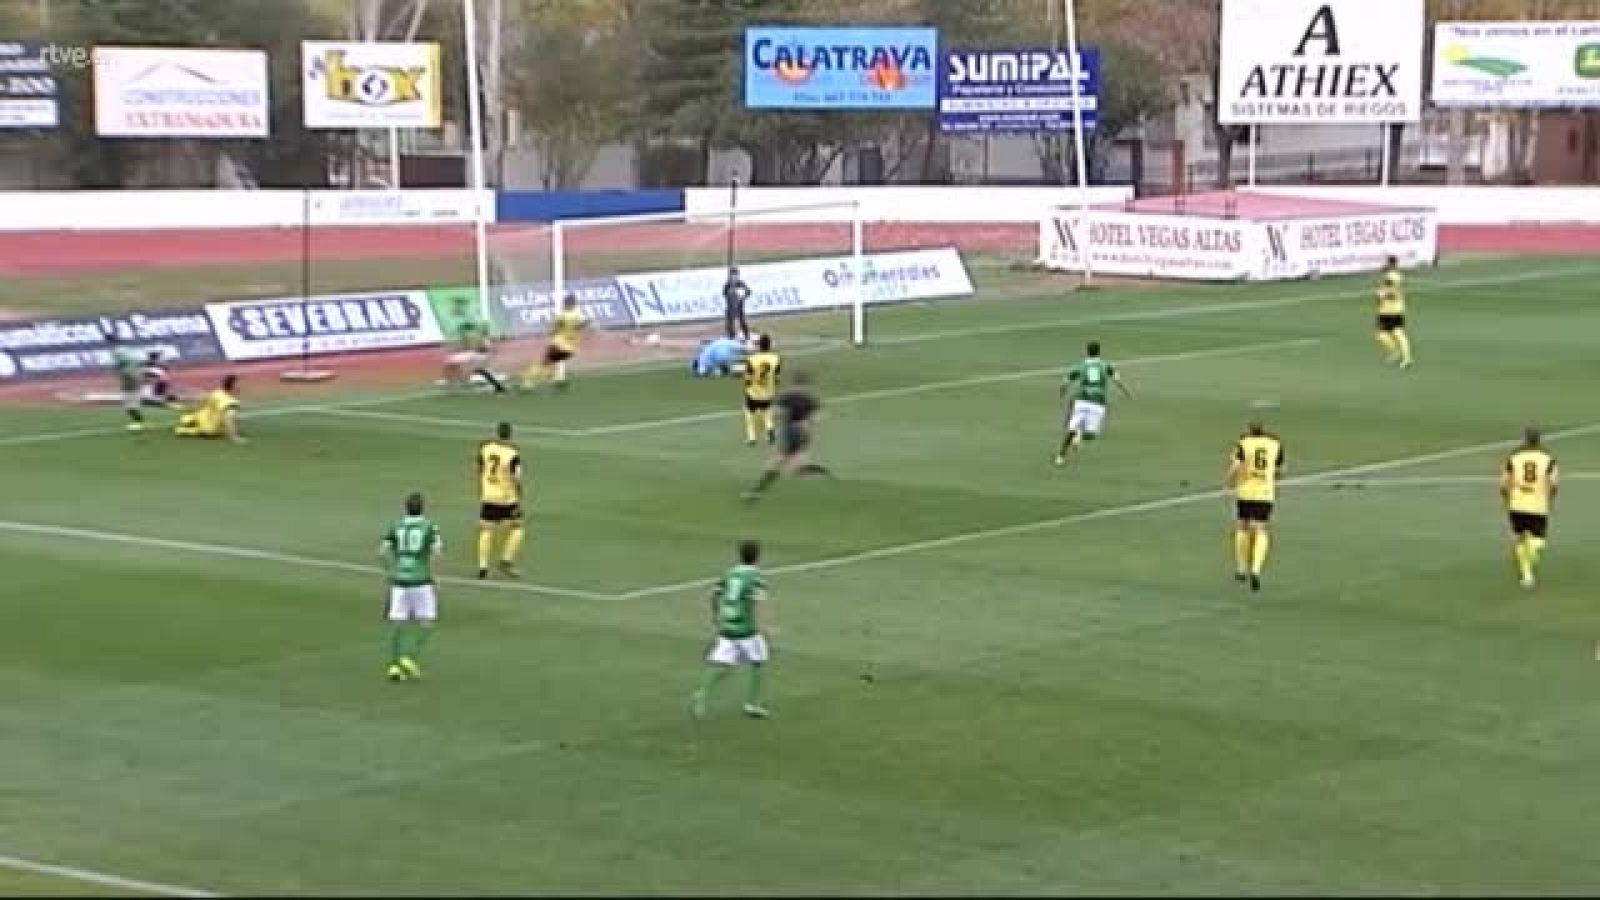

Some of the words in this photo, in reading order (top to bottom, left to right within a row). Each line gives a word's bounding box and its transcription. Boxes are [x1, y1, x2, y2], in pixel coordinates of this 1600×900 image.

[1293, 5, 1340, 55] A
[753, 39, 931, 71] CALATRAVA
[1240, 64, 1400, 97] ATHIEX
[1232, 103, 1311, 116] SISTEMAS
[1316, 103, 1337, 115] DE
[1345, 102, 1406, 116] RIEGOS
[1138, 224, 1191, 249] VEGAS
[1194, 229, 1241, 253] ALTAS
[1301, 224, 1342, 249] HOTEL
[1345, 219, 1386, 245] VEGAS
[1391, 216, 1426, 241] ALTAS
[396, 528, 424, 553] 10
